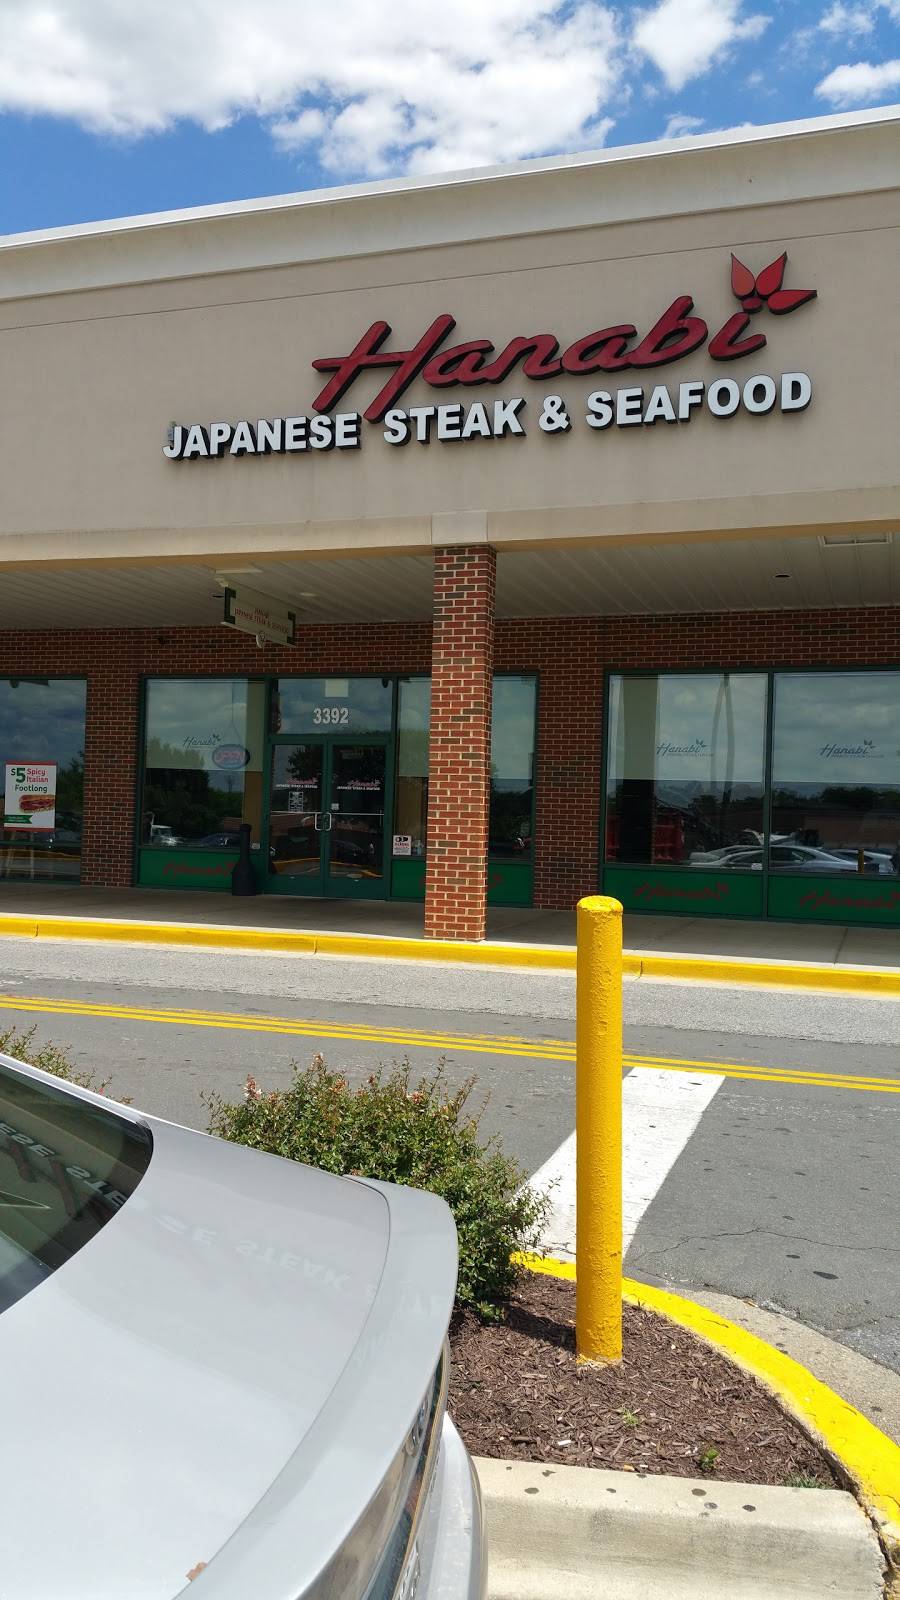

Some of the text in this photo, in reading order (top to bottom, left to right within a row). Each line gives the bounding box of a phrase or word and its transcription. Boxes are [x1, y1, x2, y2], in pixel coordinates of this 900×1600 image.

[312, 293, 768, 421] Hanabi
[162, 371, 813, 460] JAPANESE STEAK & SEAFOOD
[312, 707, 349, 725] 3392
[656, 742, 701, 757] Hanabi
[820, 743, 869, 758] Hanabi
[26, 768, 46, 776] Spicy
[14, 784, 48, 793] Footlong
